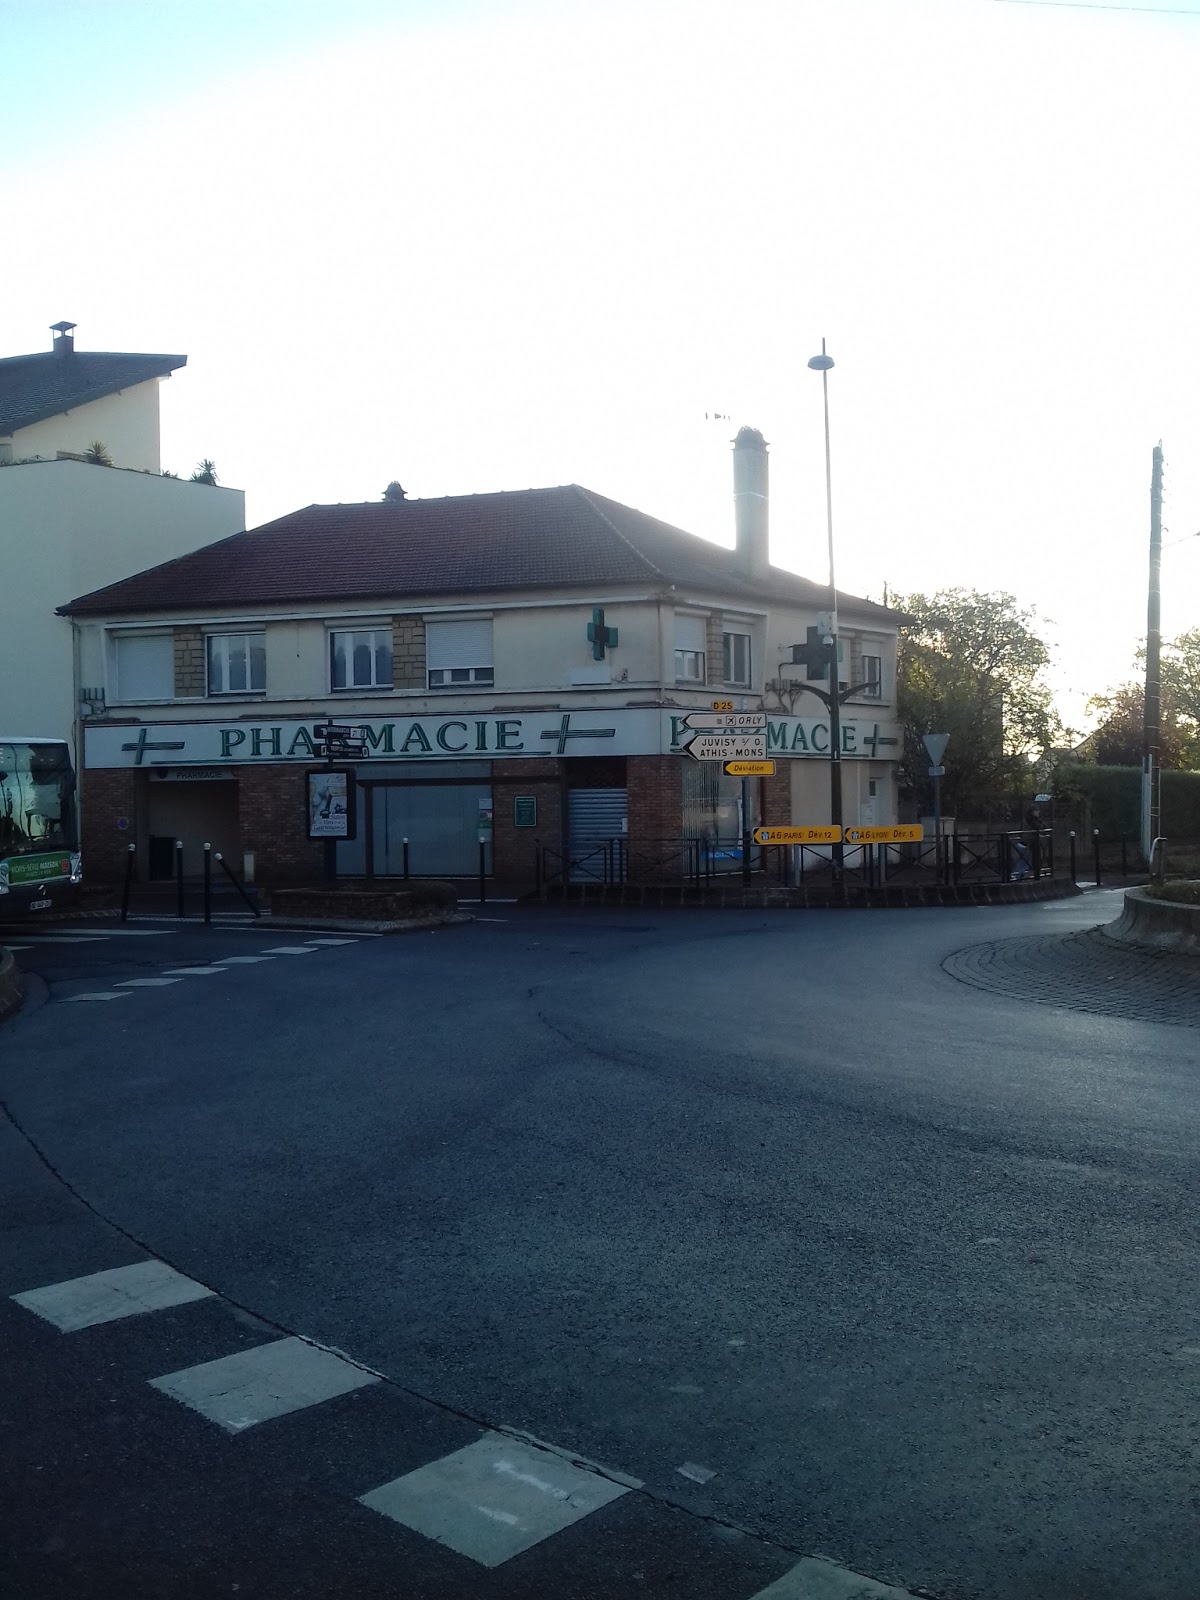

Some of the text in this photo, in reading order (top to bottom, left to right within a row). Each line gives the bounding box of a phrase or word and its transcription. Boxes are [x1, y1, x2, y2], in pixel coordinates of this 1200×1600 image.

[714, 702, 733, 710] D 25
[738, 716, 762, 725] ORLY
[220, 718, 525, 757] PHAMACIE
[701, 739, 737, 747] JUVISY
[734, 764, 764, 772] Déviation
[176, 770, 223, 780] PHARMACIE
[770, 831, 782, 840] A6
[824, 831, 833, 840] 12
[860, 831, 871, 840] A6
